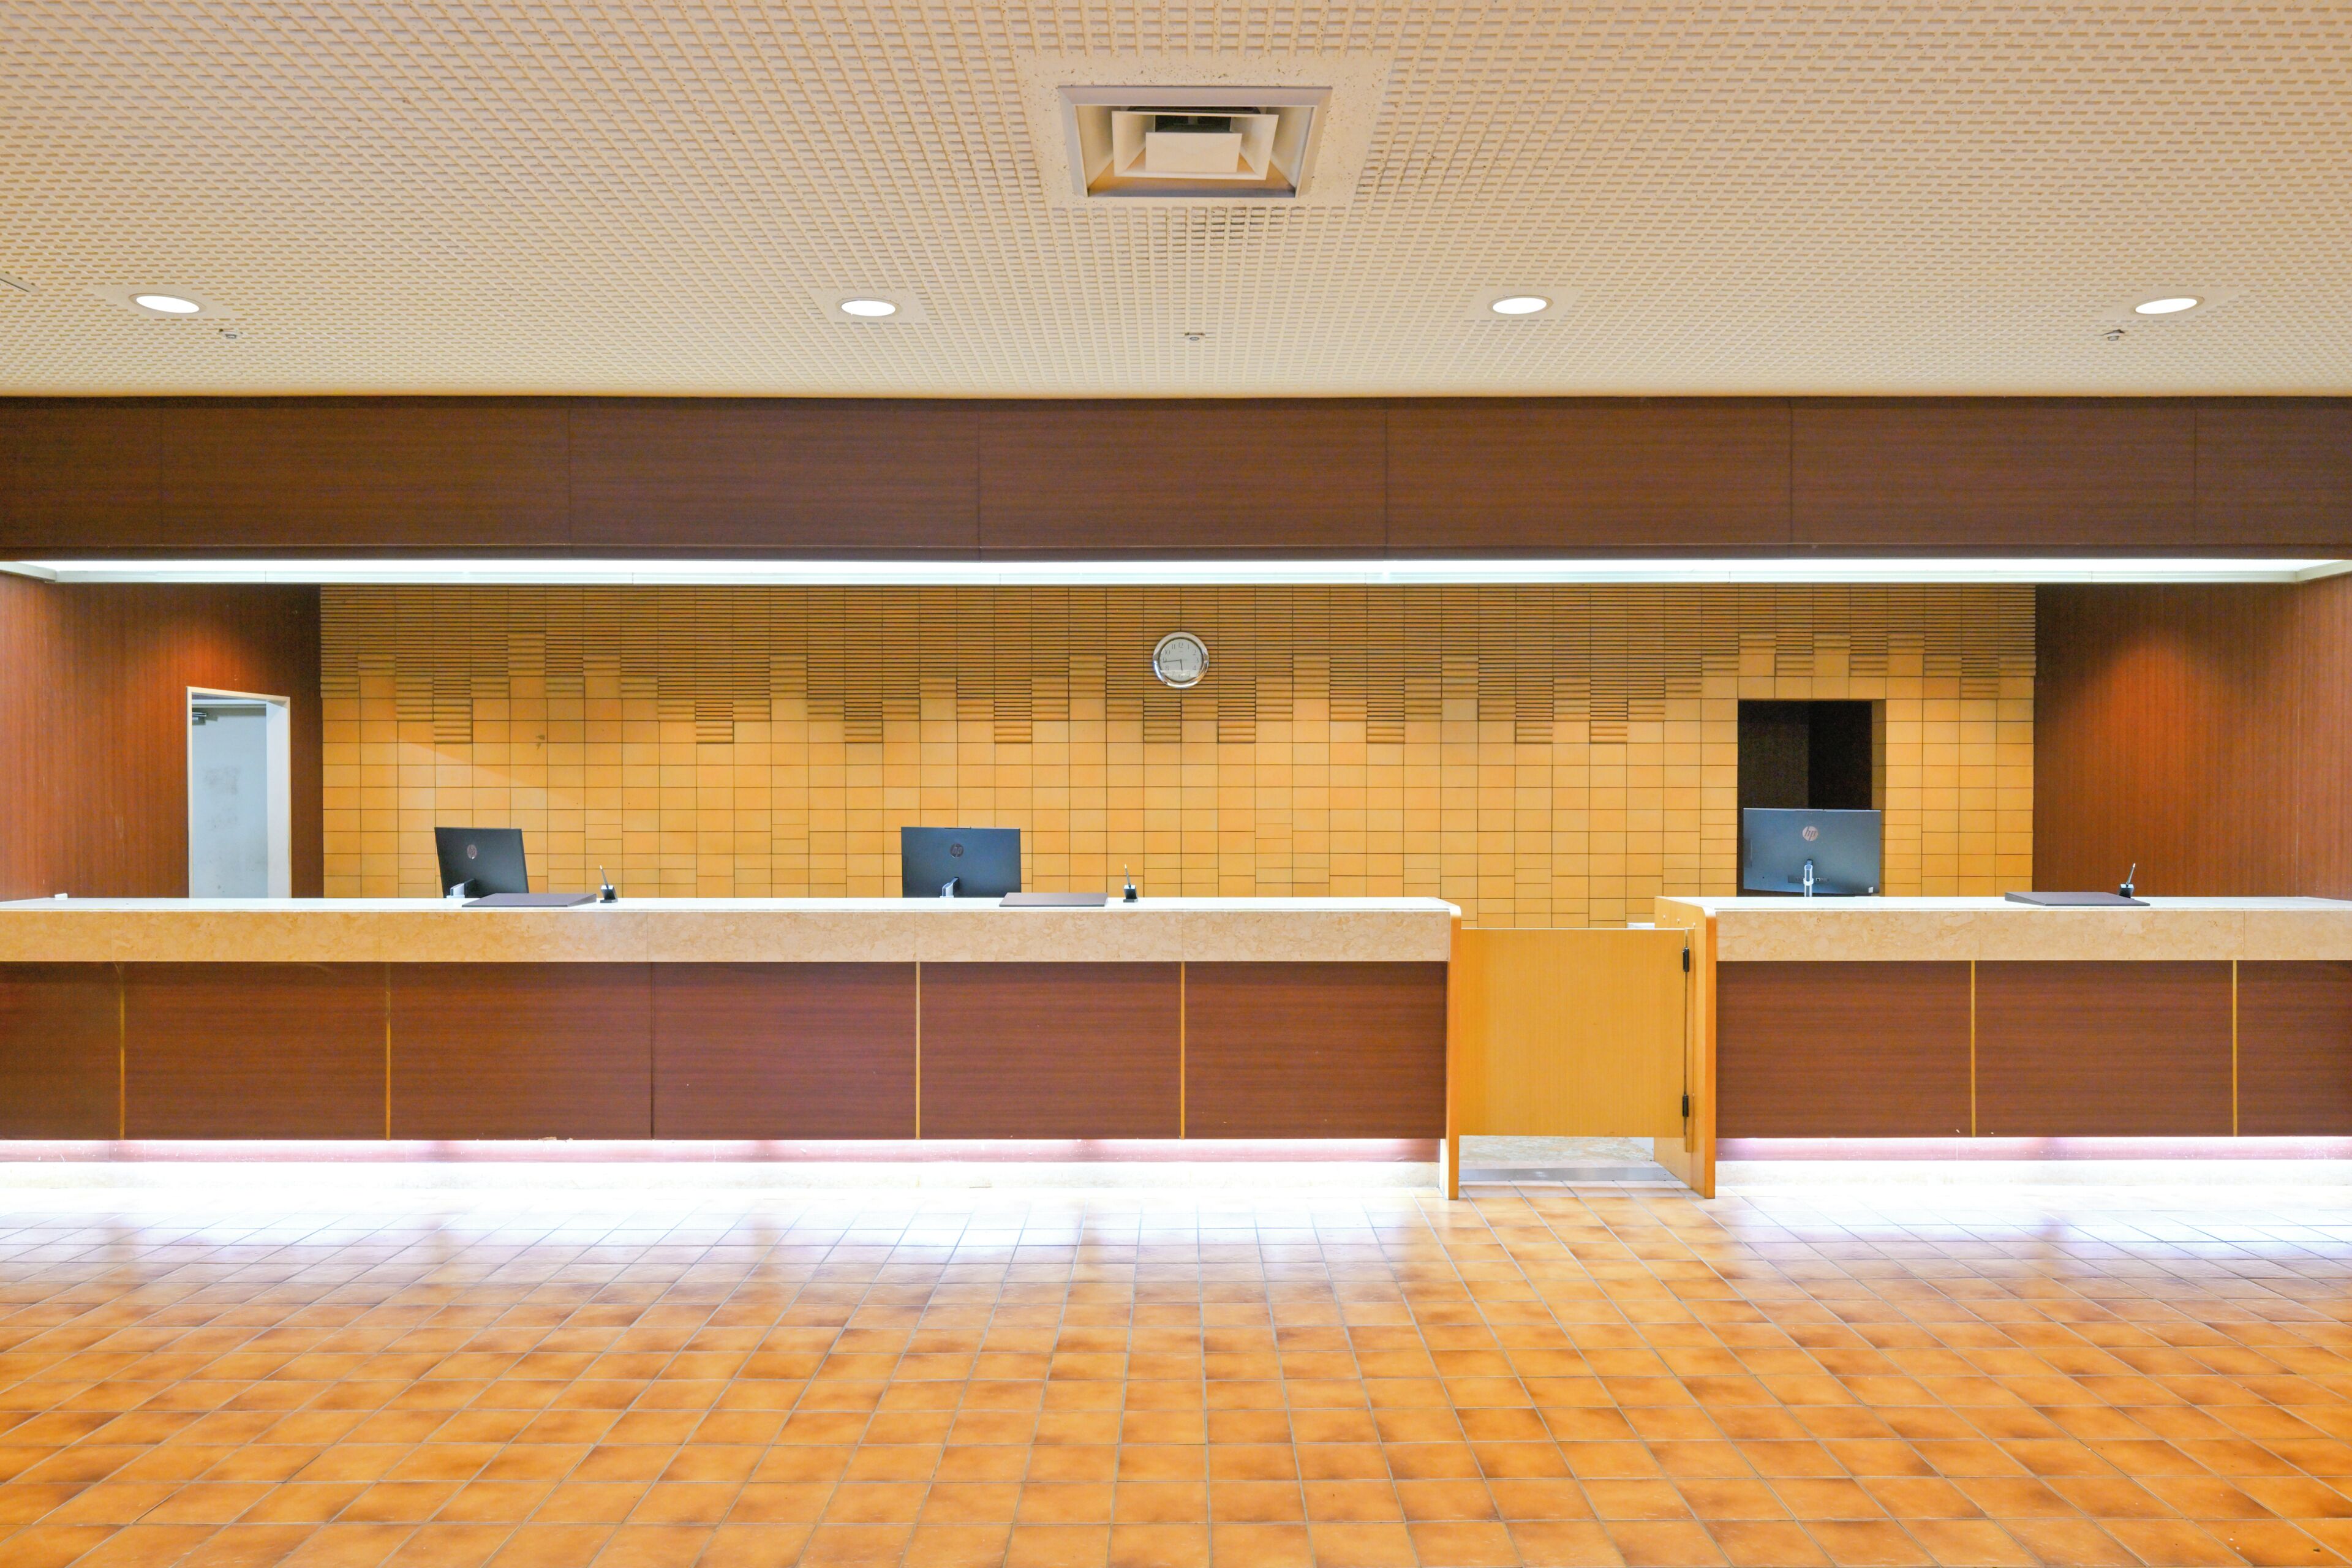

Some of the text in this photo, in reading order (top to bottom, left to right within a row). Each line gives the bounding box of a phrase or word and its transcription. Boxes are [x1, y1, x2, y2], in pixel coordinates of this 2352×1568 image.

[1804, 826, 1817, 841] hp
[468, 845, 476, 858] hp
[952, 843, 963, 858] hp
